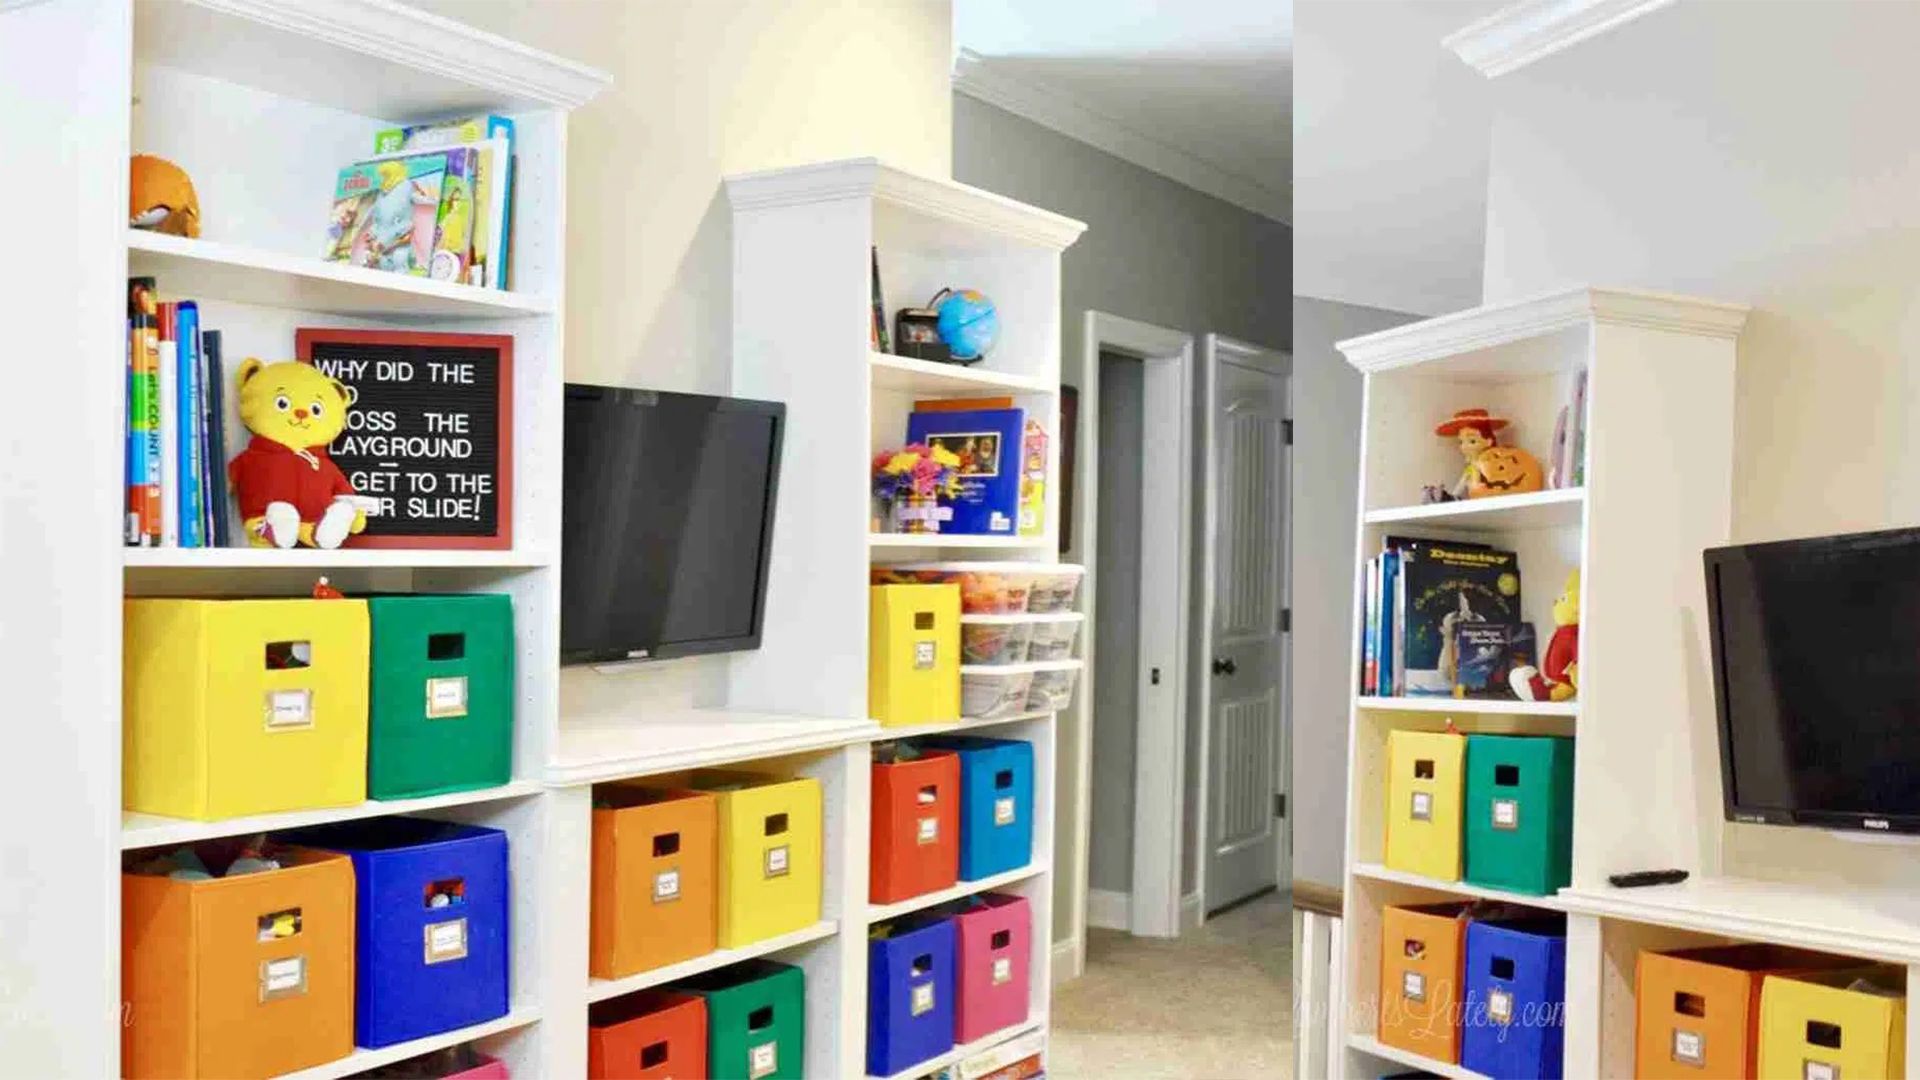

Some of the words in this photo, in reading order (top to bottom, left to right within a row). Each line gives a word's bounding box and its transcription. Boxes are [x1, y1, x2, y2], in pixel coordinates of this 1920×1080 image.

[314, 359, 369, 380] WHY
[376, 361, 414, 381] DID
[427, 363, 475, 384] THE
[148, 404, 160, 455] COUNT
[345, 410, 397, 431] OSS
[424, 413, 470, 434] THE
[328, 436, 473, 458] LAYGROUND
[351, 471, 400, 492] GET
[406, 473, 437, 493] TO
[446, 474, 493, 494] THE
[407, 495, 481, 521] SLIDE!
